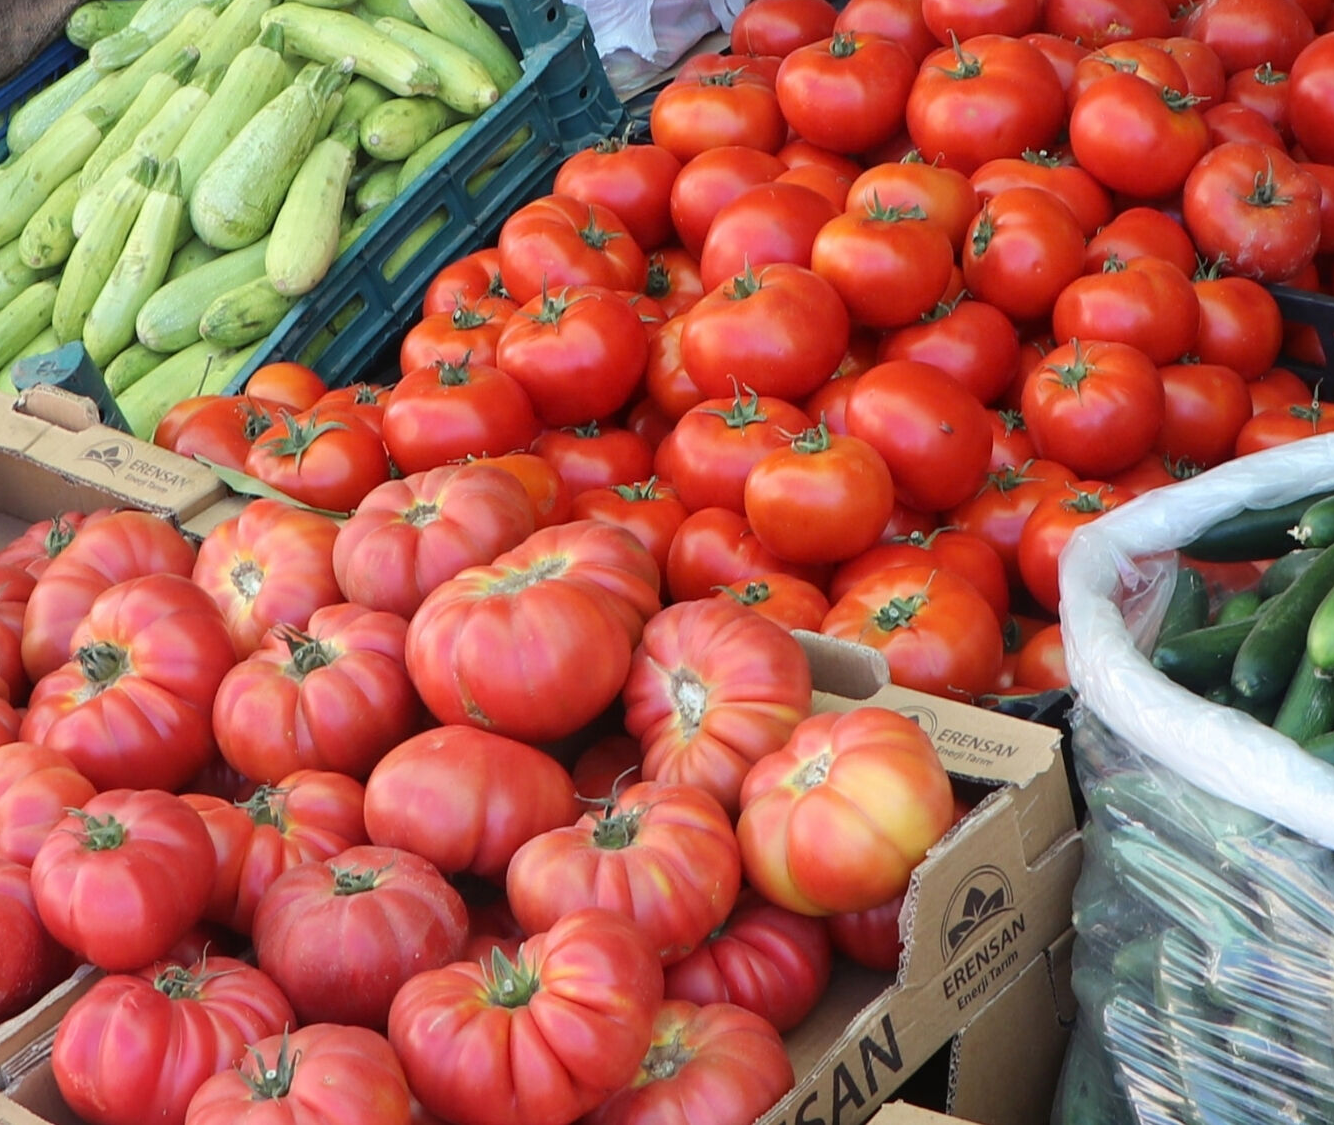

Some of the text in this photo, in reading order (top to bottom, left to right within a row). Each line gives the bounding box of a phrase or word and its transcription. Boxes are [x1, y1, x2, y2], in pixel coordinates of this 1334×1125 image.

[128, 458, 193, 489] ERENSAN
[937, 728, 1019, 759] ERENSAN
[943, 912, 1027, 1000] ERENSAN
[957, 950, 1019, 1011] Enerji Tarım
[778, 1012, 904, 1125] SAN
